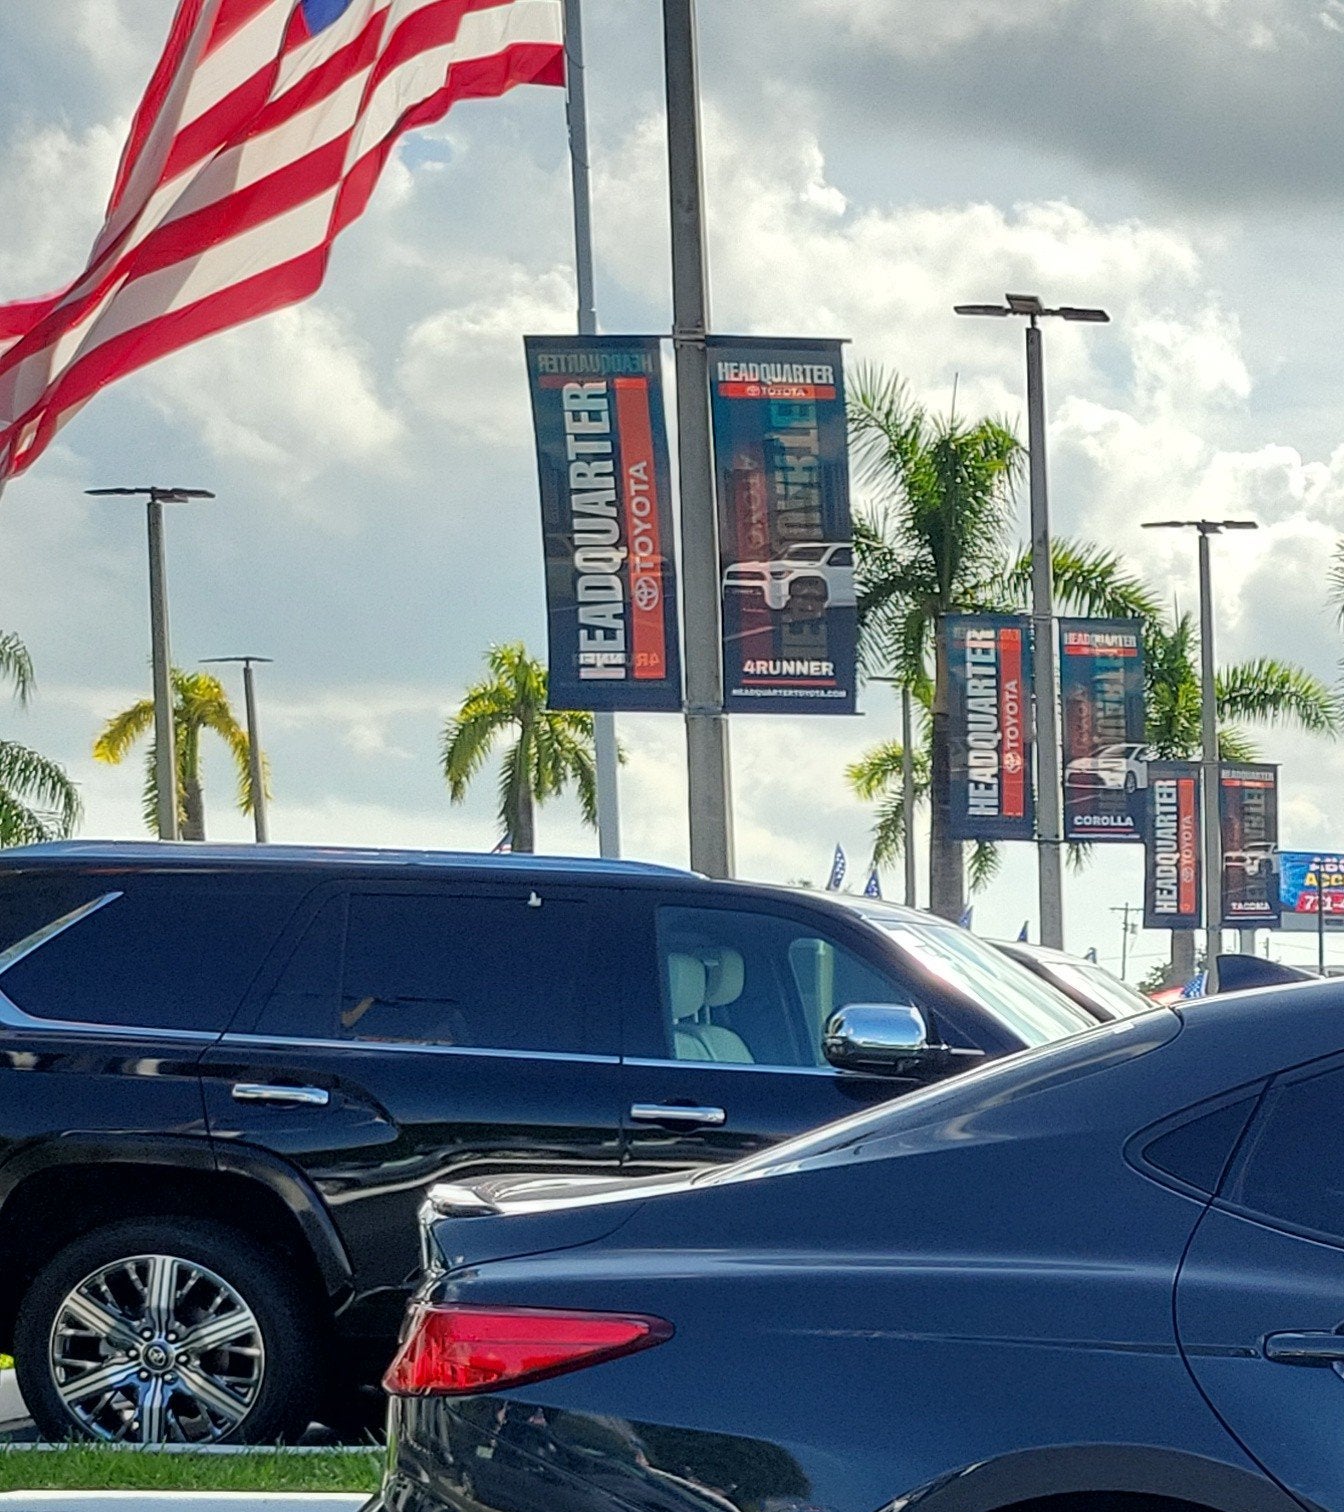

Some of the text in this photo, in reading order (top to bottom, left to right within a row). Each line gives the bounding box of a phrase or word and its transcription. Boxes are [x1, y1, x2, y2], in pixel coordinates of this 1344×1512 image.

[718, 362, 834, 385] HEADQUARTER
[761, 387, 806, 396] TOYOTA
[563, 380, 628, 680] HEADQUARTER
[628, 461, 659, 569] TOYOTA
[743, 660, 835, 676] 4RUNNER
[966, 629, 1002, 816] HEADQUARTER
[1005, 679, 1020, 749] TOYOTA
[1074, 815, 1134, 827] COROLLA
[1155, 780, 1180, 914] HEADQUARTER
[1182, 815, 1193, 865] TOYOTA
